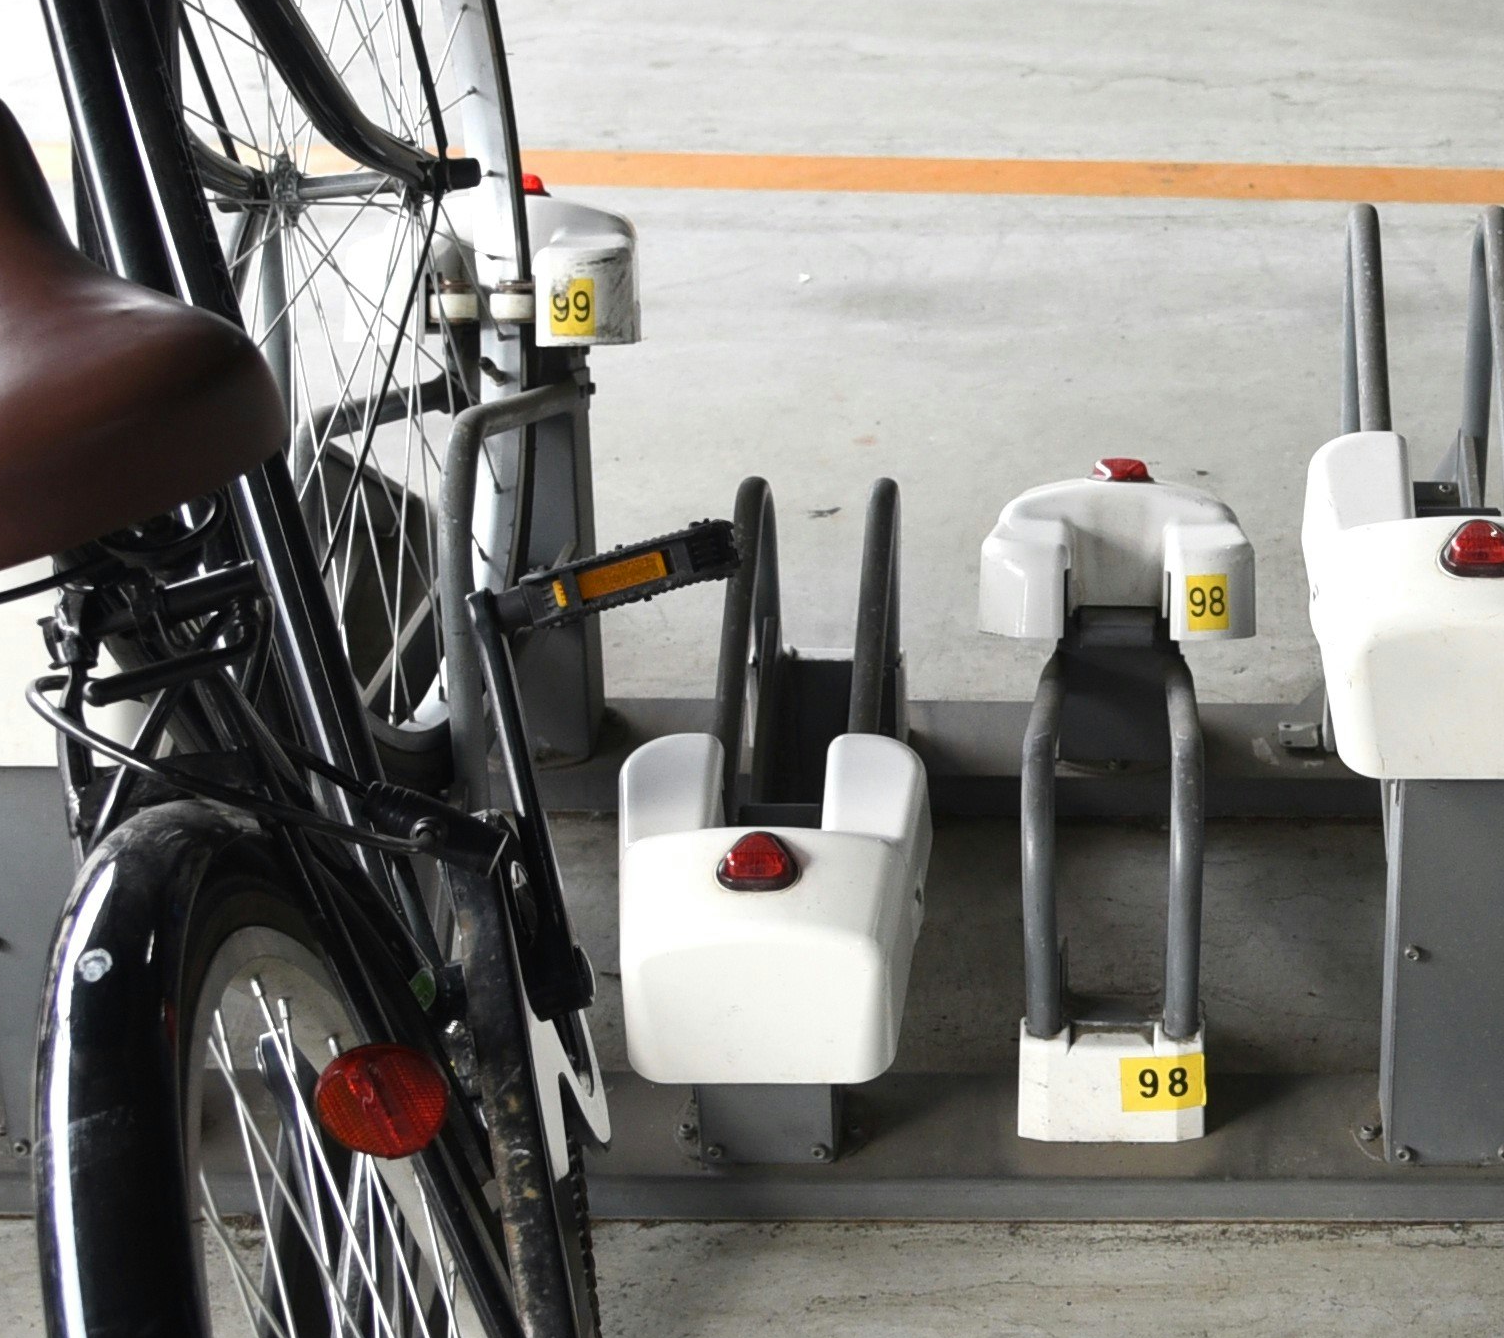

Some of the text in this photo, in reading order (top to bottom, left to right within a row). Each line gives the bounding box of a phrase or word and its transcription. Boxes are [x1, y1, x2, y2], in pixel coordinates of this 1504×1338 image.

[552, 290, 591, 323] 99
[1189, 586, 1226, 618] 98
[1138, 1067, 1189, 1098] 98
